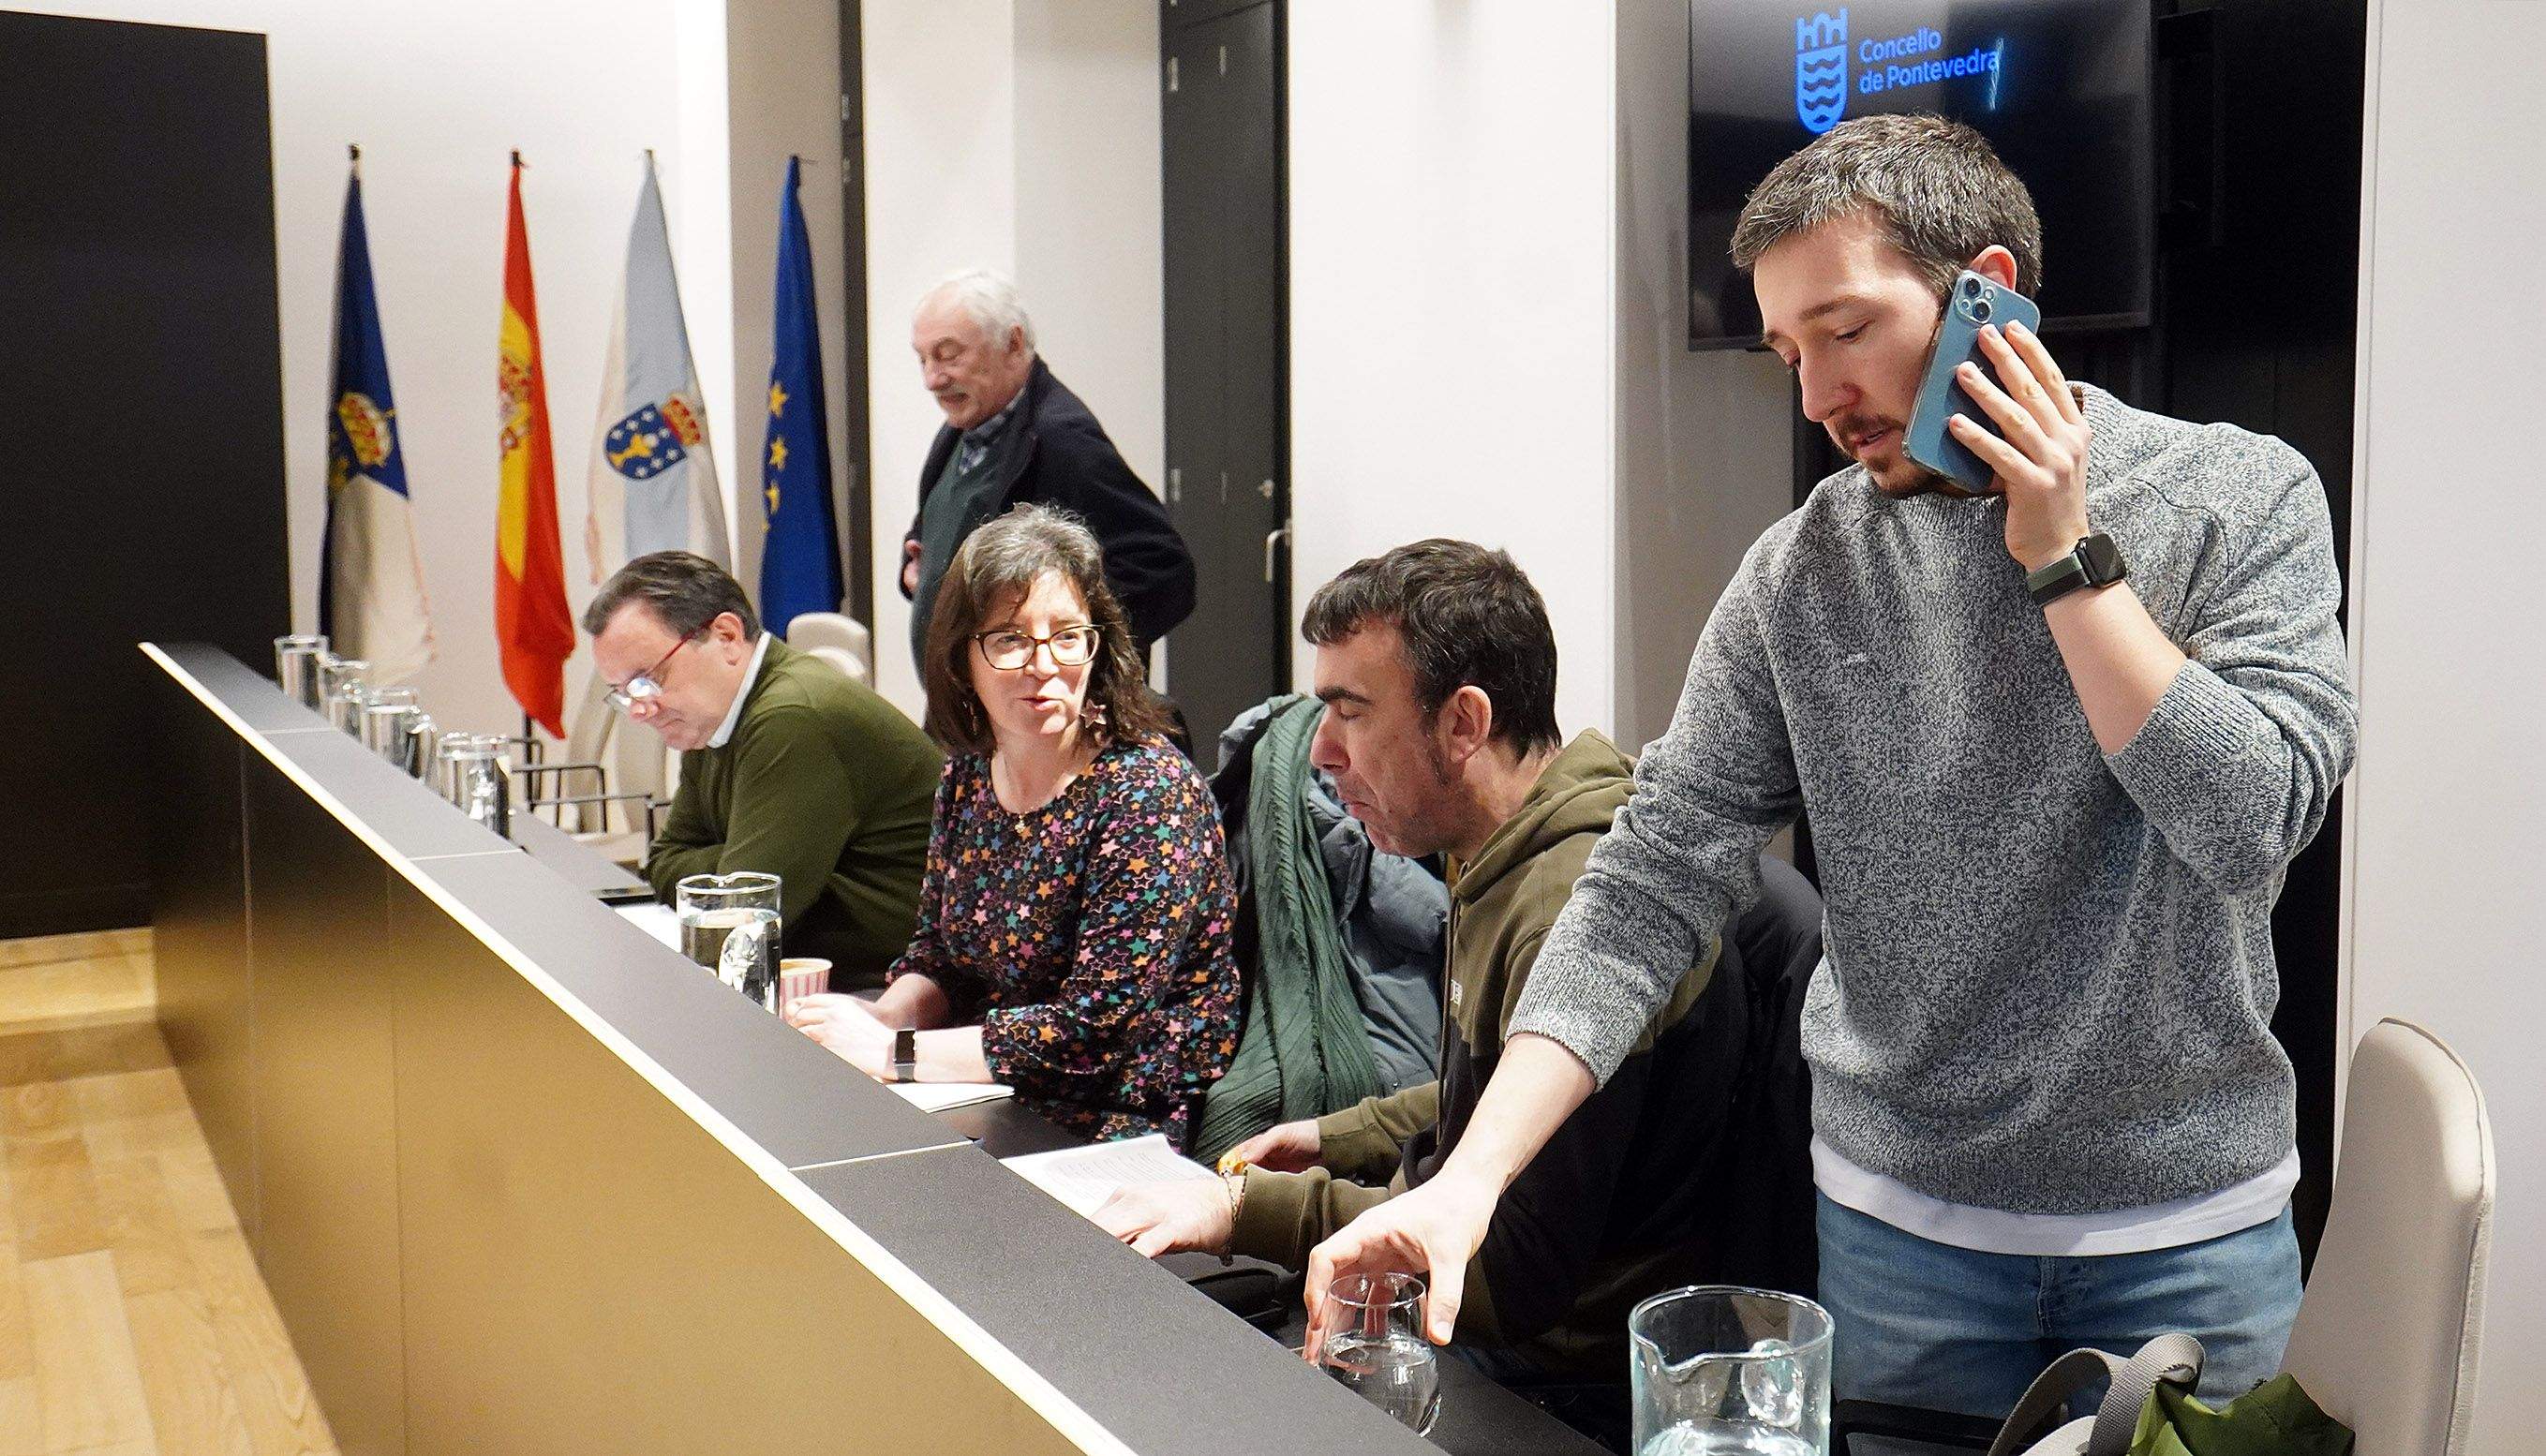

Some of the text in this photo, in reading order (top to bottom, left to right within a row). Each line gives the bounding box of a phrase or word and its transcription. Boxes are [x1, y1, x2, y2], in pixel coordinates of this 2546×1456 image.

[1859, 27, 1942, 64] Concello
[1859, 49, 1999, 94] de Pontevedra
